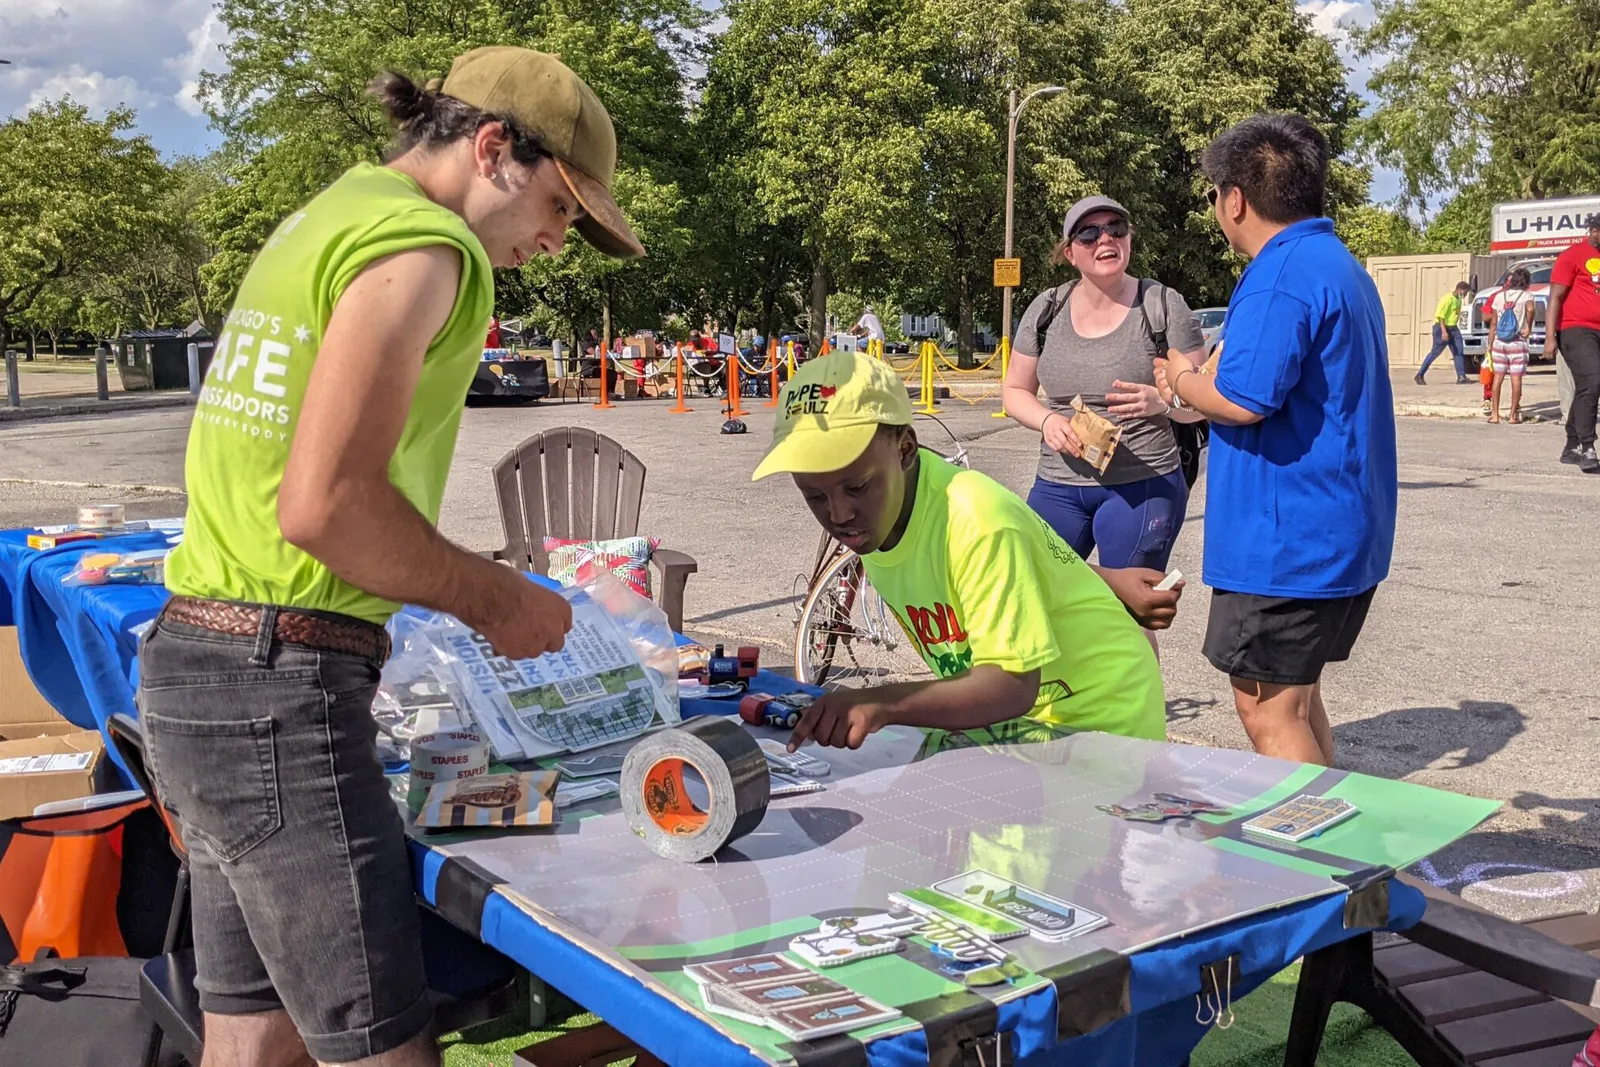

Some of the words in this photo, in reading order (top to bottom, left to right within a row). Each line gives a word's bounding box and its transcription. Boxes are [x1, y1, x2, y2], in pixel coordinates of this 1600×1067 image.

[1506, 213, 1592, 234] U-HAU
[205, 330, 291, 398] AFE
[199, 386, 290, 425] ASSADORS
[519, 660, 546, 685] CHI
[431, 756, 468, 764] STAPLES
[456, 765, 487, 779] STAPLES
